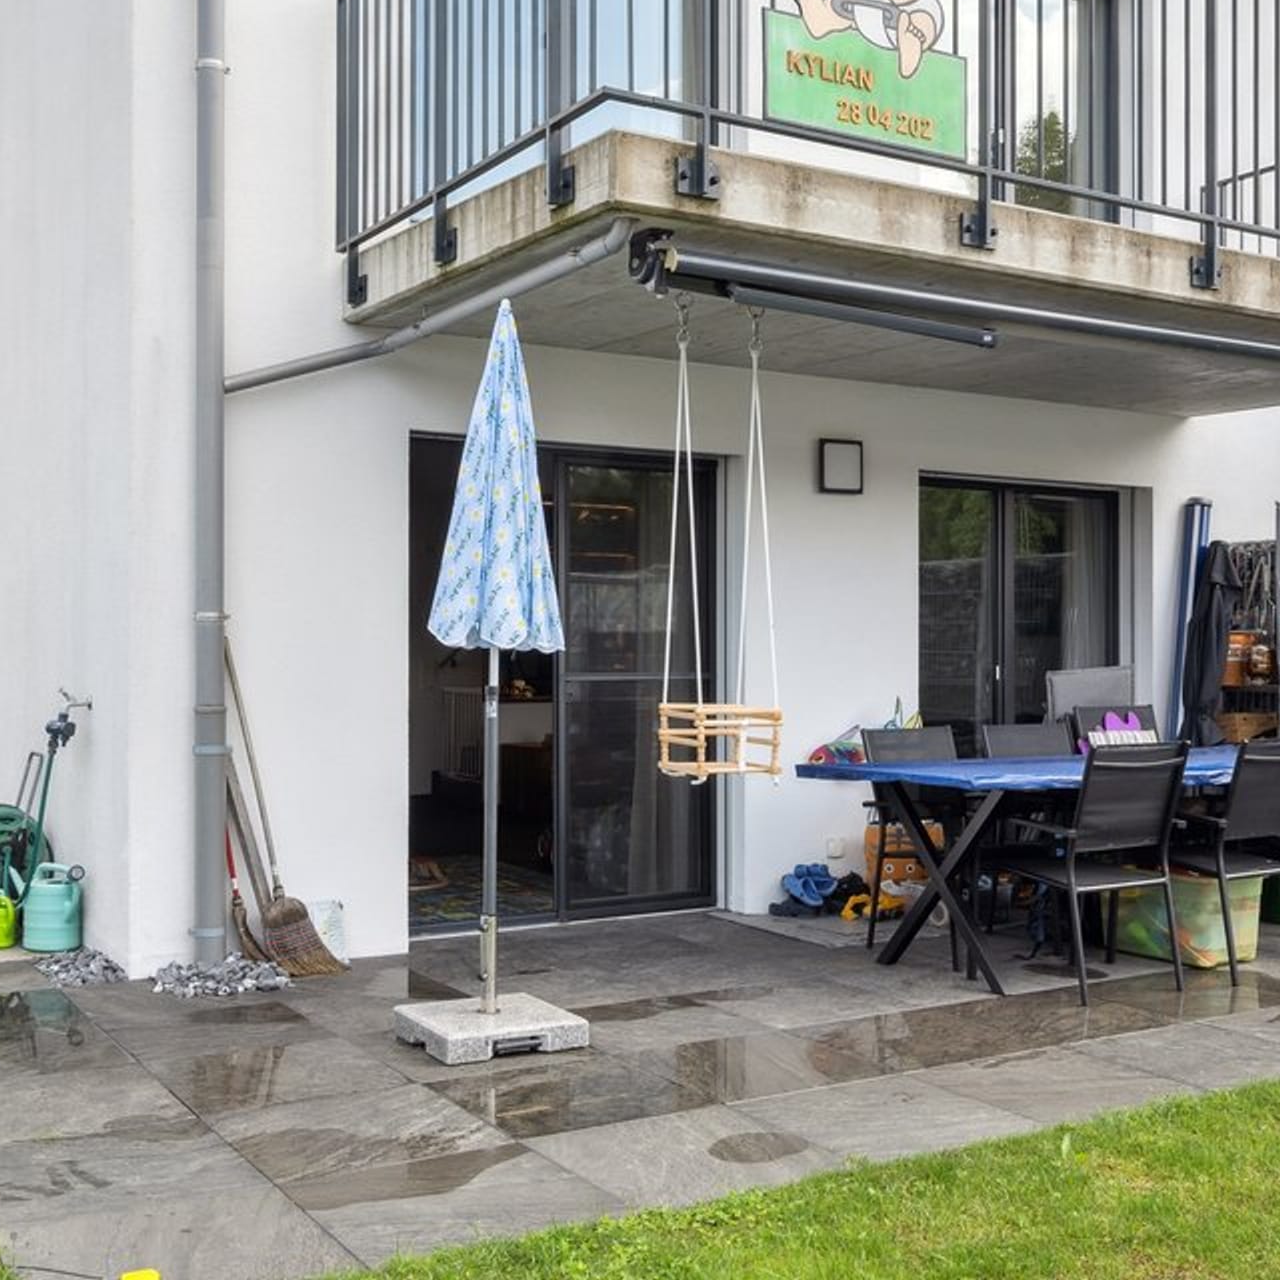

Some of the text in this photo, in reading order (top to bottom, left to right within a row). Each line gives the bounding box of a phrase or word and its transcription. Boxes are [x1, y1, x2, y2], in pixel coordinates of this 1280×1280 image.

[786, 50, 874, 92] KYLIAN
[837, 97, 934, 140] 28 04 202
